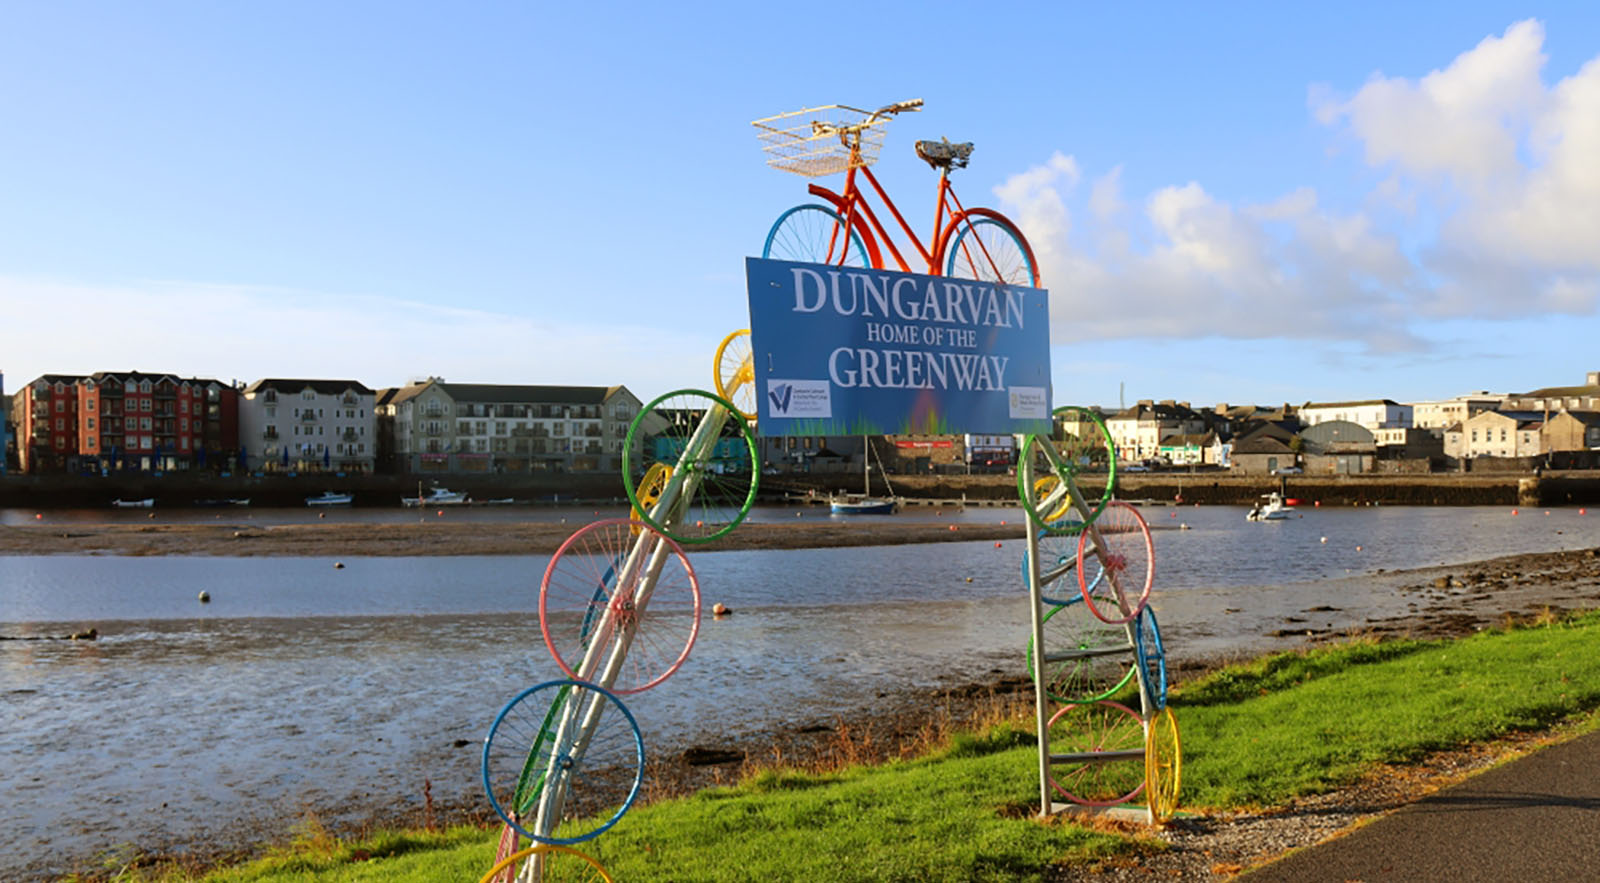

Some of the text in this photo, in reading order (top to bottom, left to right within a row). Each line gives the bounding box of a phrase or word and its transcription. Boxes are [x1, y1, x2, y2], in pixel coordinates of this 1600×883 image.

[790, 268, 1025, 329] DUNGARVAN
[866, 322, 977, 348] HOME OF THE
[828, 347, 1008, 392] GREENWAY
